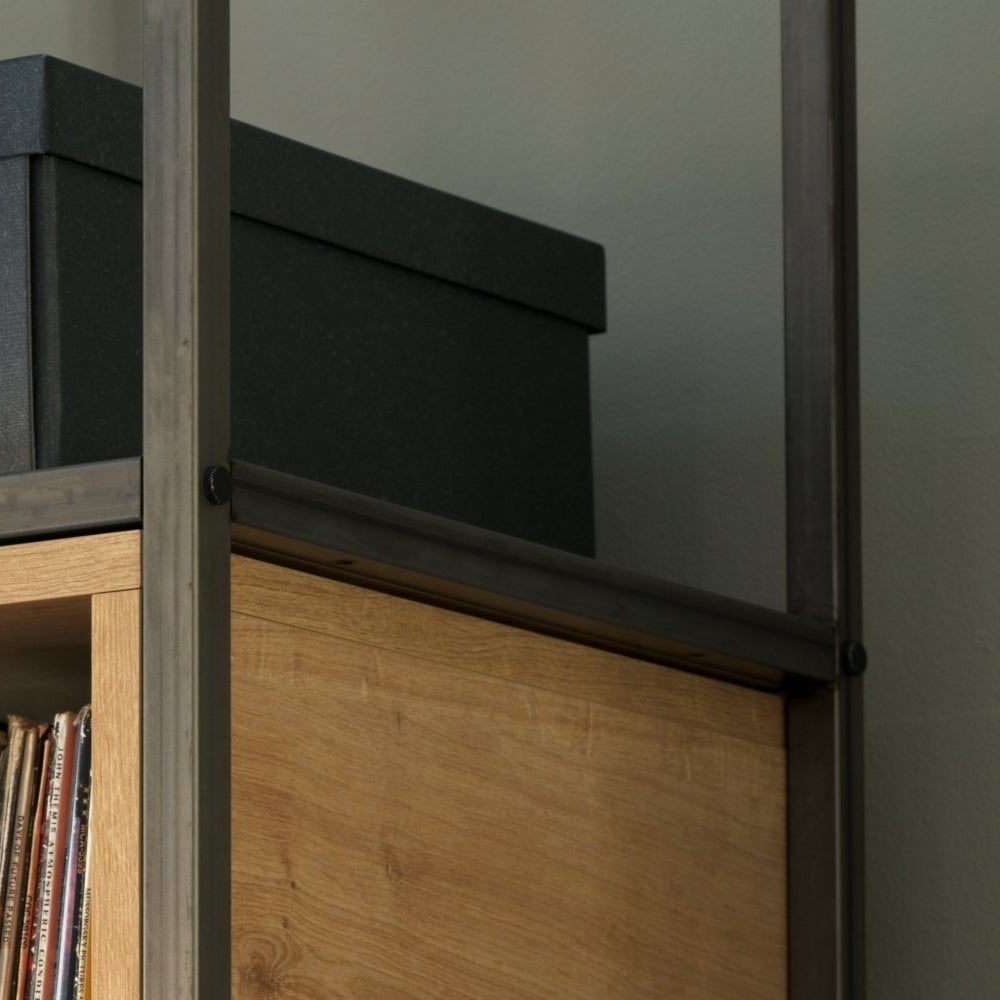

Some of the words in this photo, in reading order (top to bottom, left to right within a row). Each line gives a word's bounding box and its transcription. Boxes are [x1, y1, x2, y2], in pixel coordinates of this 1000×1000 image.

[53, 746, 64, 779] JOHN
[14, 814, 25, 842] DAYS
[49, 786, 60, 832] THEMIS
[12, 844, 21, 856] OF
[7, 861, 19, 901] FUTURE
[39, 840, 55, 944] ATMOSPHERIC
[2, 905, 14, 943] PASSED
